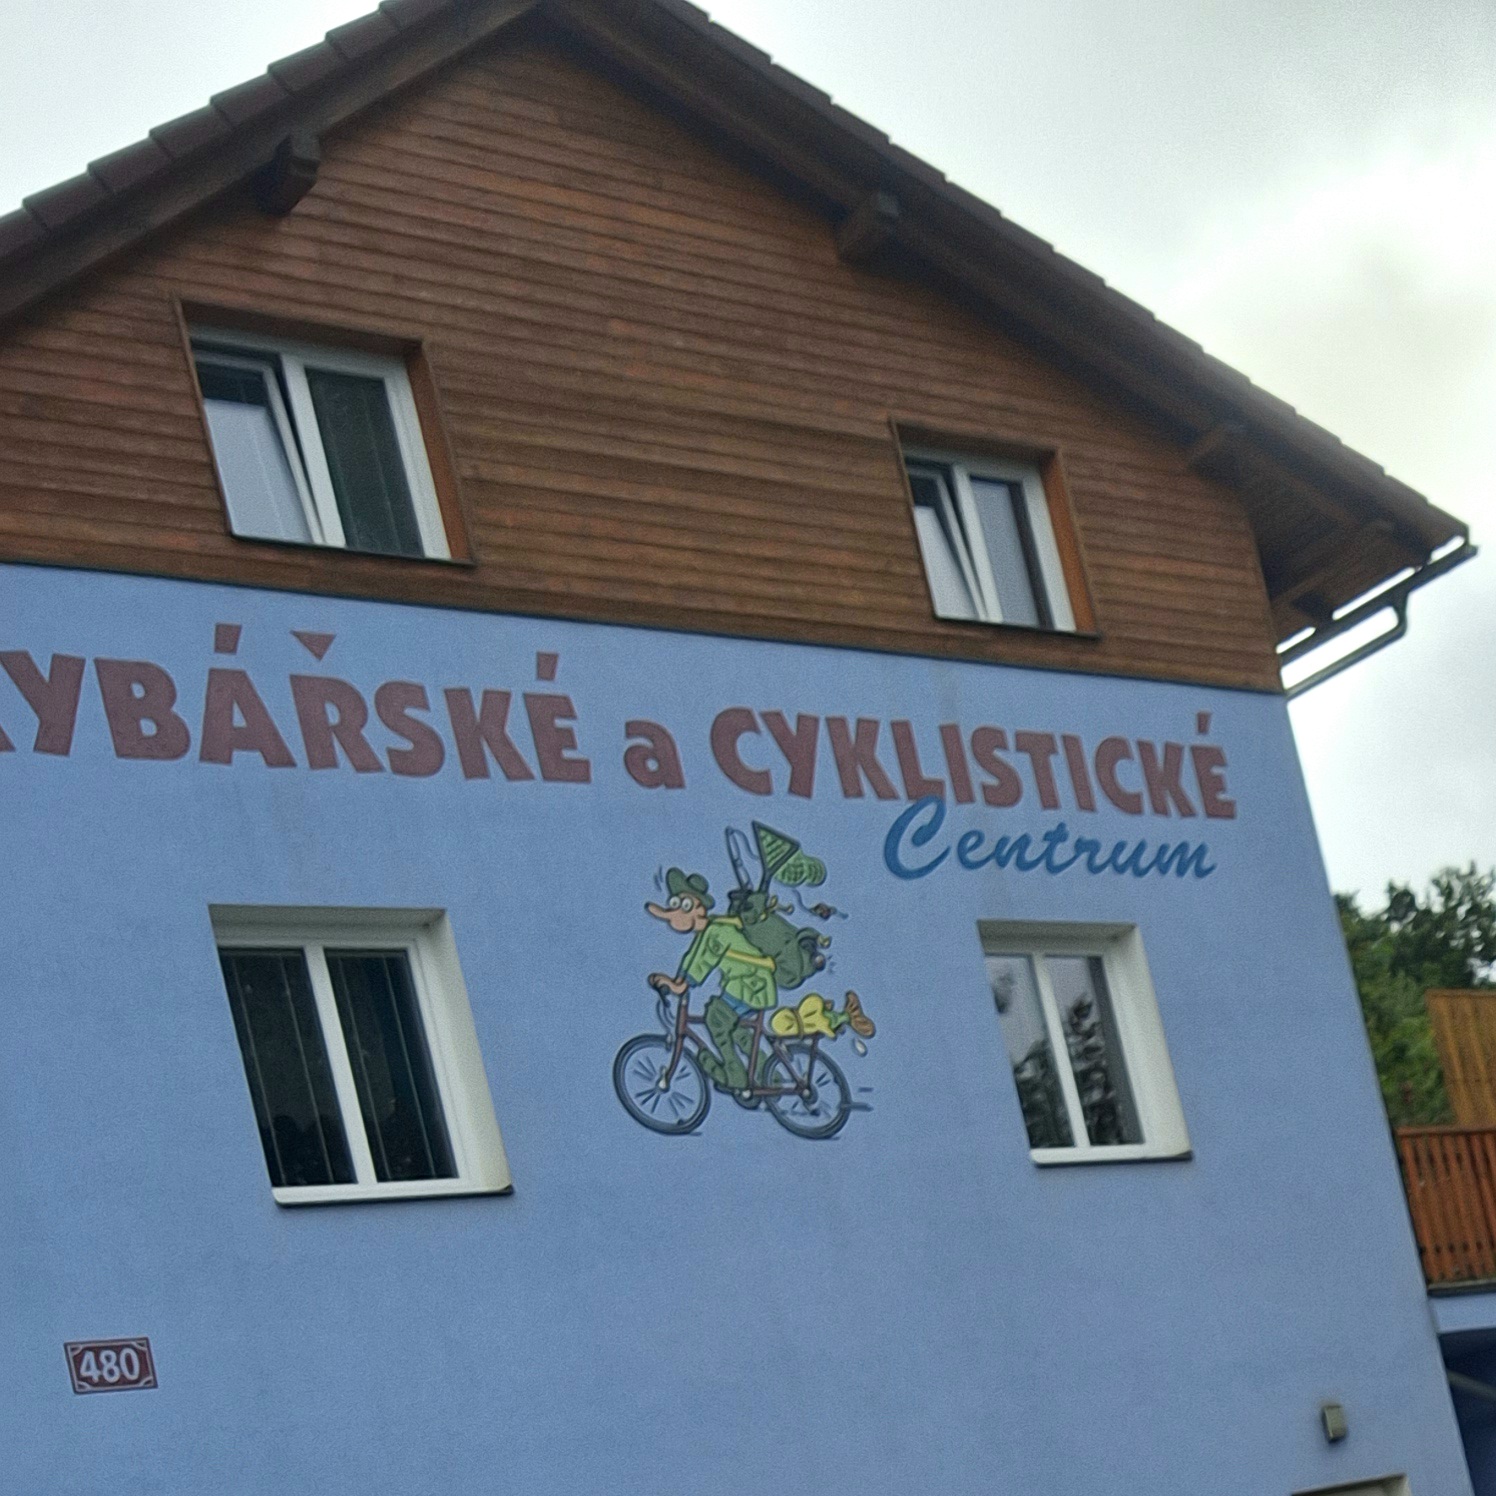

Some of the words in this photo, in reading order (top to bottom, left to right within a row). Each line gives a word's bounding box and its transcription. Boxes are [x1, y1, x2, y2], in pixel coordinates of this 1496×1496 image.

[0, 622, 591, 784] YBÁŘSKÉ
[624, 719, 686, 790] a
[710, 707, 1237, 819] CYKLISTICKÉ
[883, 795, 1217, 880] Centrum
[80, 1347, 140, 1383] 480
